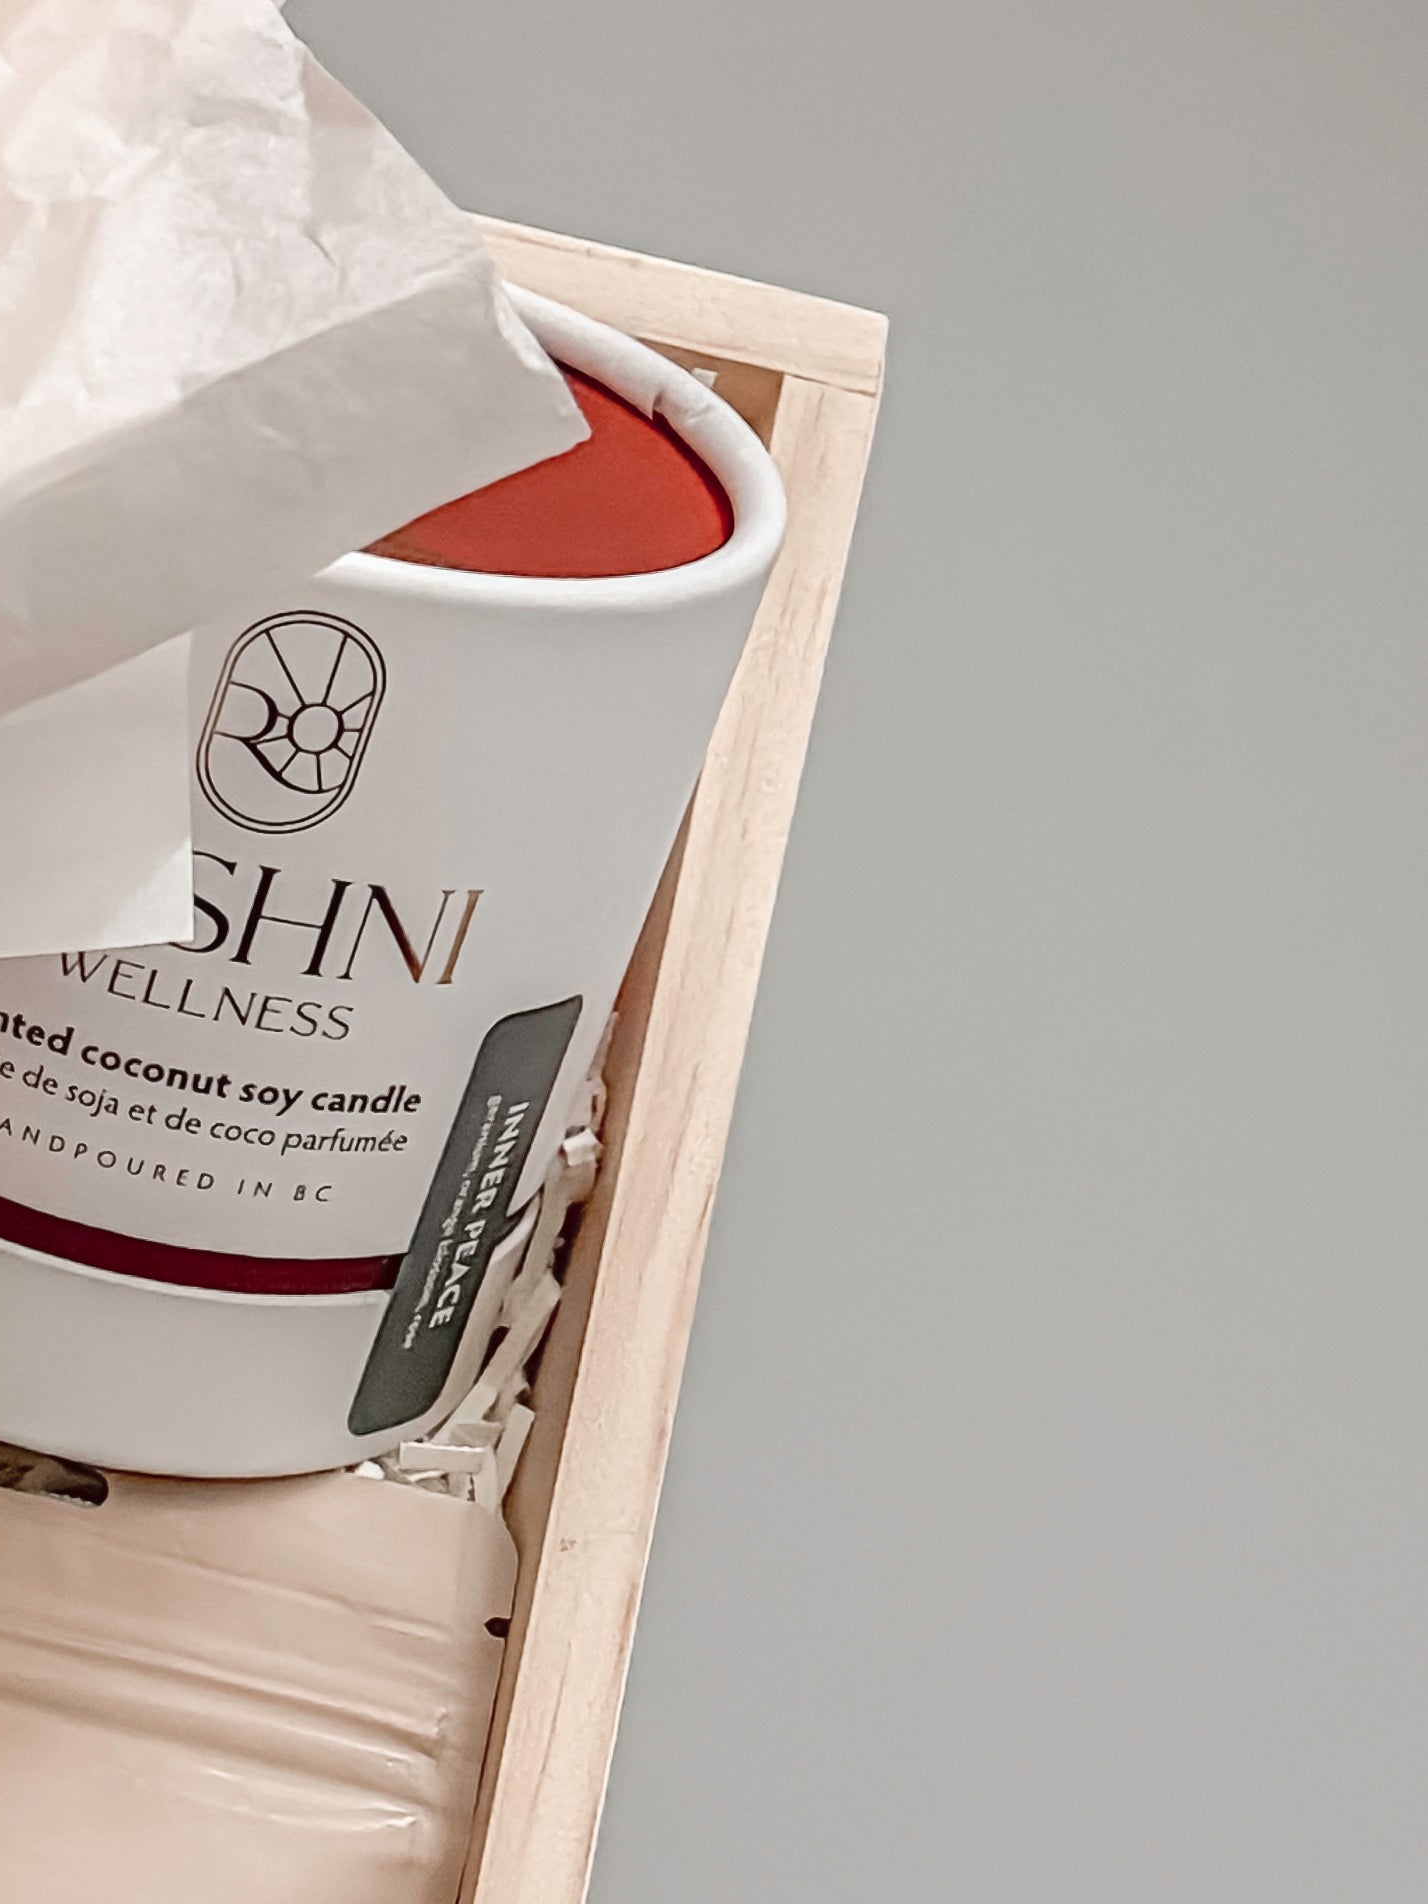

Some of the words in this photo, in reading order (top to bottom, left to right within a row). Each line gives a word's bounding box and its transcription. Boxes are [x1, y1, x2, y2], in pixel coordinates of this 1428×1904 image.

[61, 951, 354, 1041] WELLNESS
[21, 1064, 59, 1096] de
[64, 1084, 120, 1118] soja
[128, 1099, 158, 1126] et
[164, 1106, 202, 1135] de
[209, 1120, 277, 1147] coco
[280, 1126, 409, 1156] parfumée
[81, 1042, 232, 1100] coconut
[239, 1082, 304, 1117] soy
[310, 1085, 423, 1115] candle
[237, 1179, 273, 1199] IN
[293, 1183, 333, 1203] BC
[472, 1100, 530, 1215] INNER
[427, 1218, 486, 1330] PEACE
